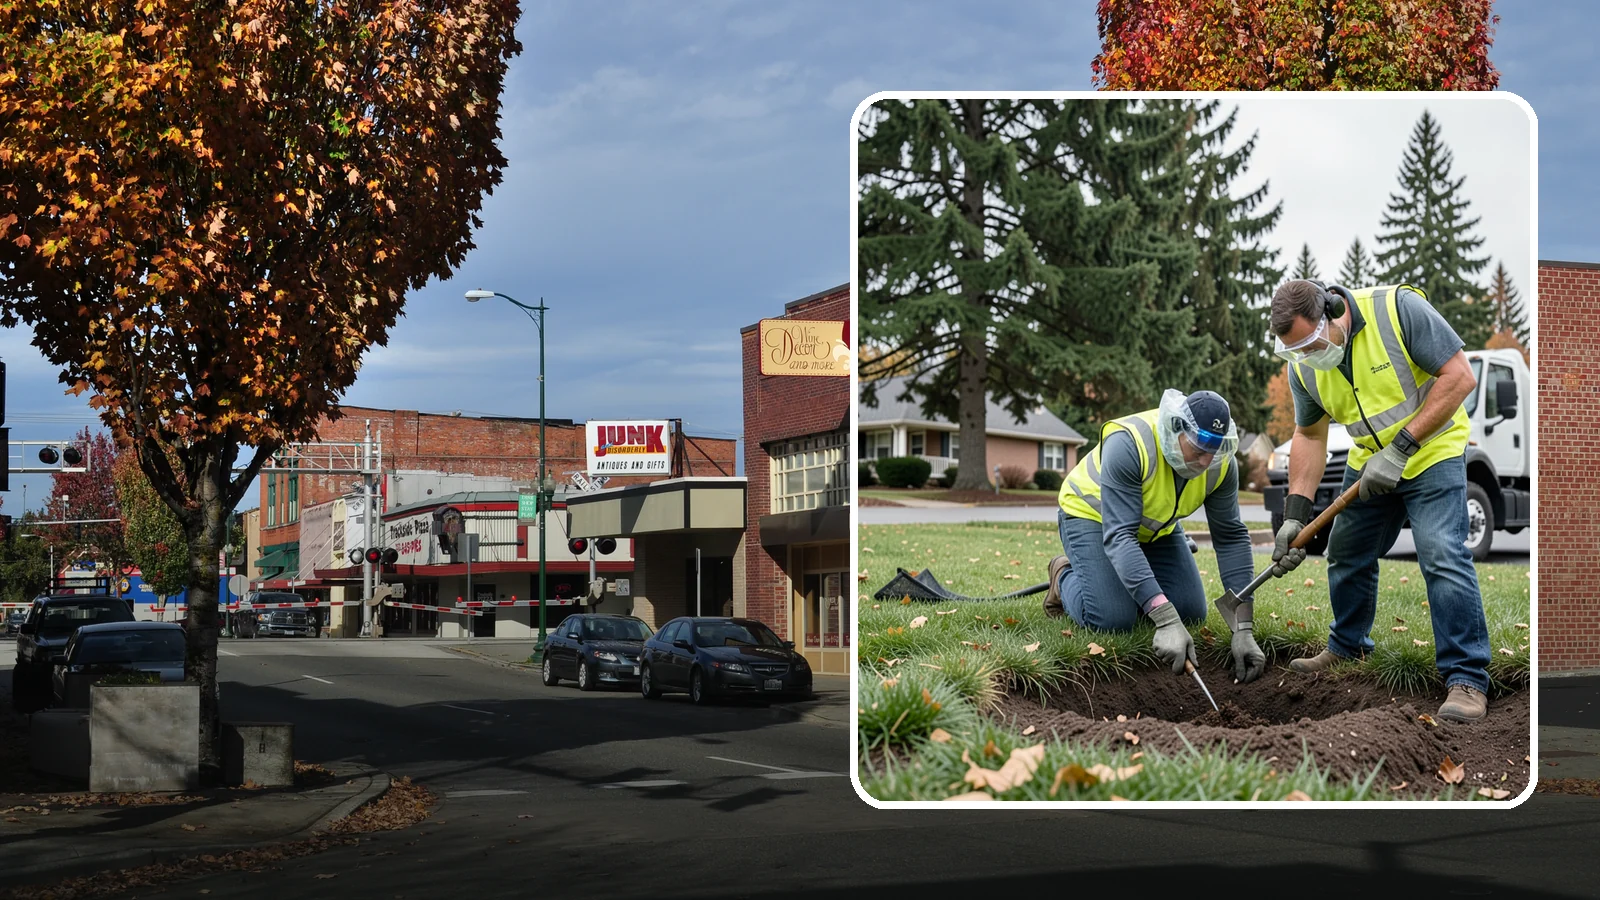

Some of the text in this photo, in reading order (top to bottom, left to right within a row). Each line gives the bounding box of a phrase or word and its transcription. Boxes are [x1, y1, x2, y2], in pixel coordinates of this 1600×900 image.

[765, 327, 831, 365] Decor
[595, 425, 665, 457] JUNK
[607, 446, 646, 454] DISORDERLY
[596, 460, 666, 470] ANTIQUES AND GIFTS
[573, 473, 587, 491] RAIL
[589, 476, 608, 492] SING
[352, 498, 365, 511] CRO
[414, 519, 429, 535] Pizza
